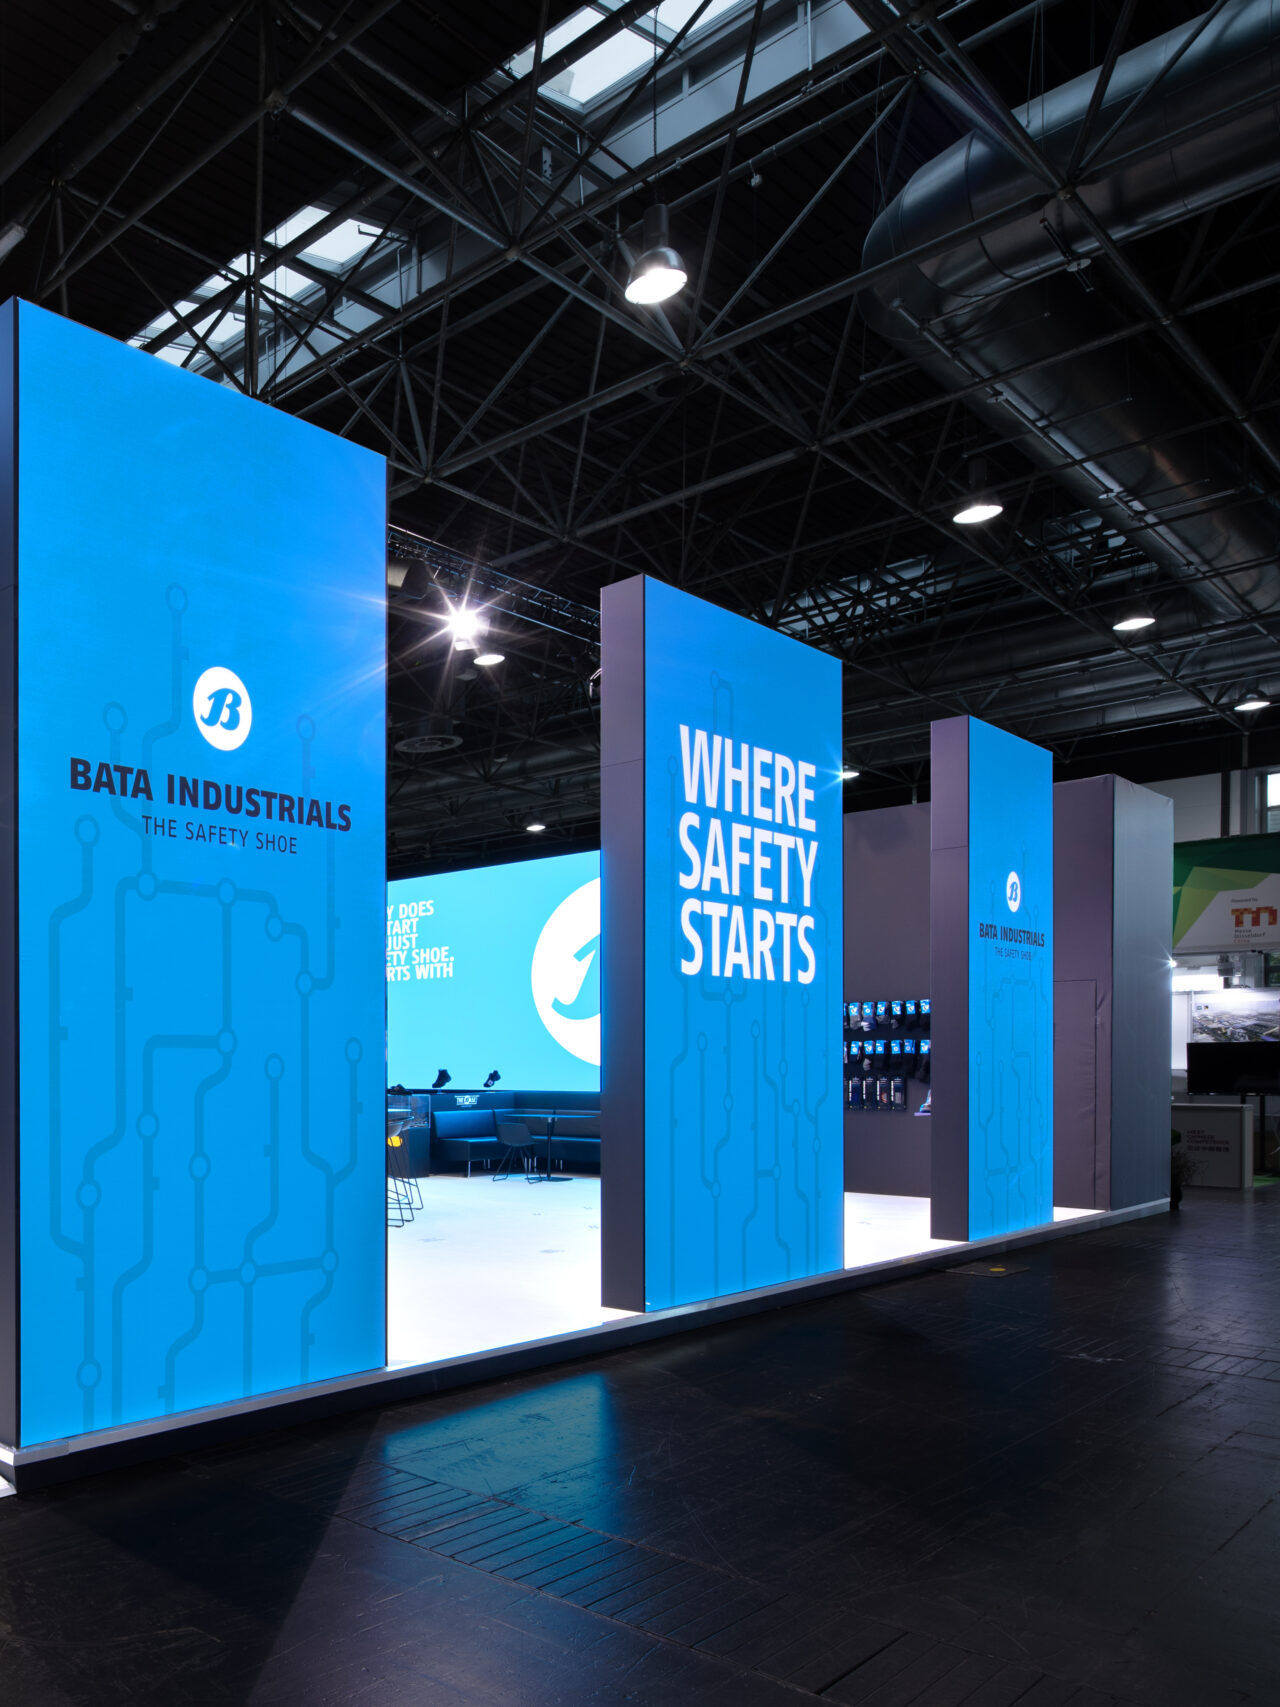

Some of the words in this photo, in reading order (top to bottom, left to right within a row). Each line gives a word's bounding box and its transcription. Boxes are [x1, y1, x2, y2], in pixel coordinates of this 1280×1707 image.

[70, 757, 154, 801] BATA
[167, 773, 352, 832] INDUSTRIALS
[679, 723, 816, 832] WHERE
[142, 815, 177, 838] THE
[185, 821, 249, 848] SAFETY
[256, 832, 297, 854] SHOE
[678, 811, 818, 907] SAFETY
[399, 900, 434, 919] DOES
[680, 898, 816, 984] STARTS
[979, 922, 998, 940] BATA
[1000, 926, 1045, 947] INDUSTRIALS
[412, 946, 455, 964] SHOE.
[415, 962, 453, 980] WITH
